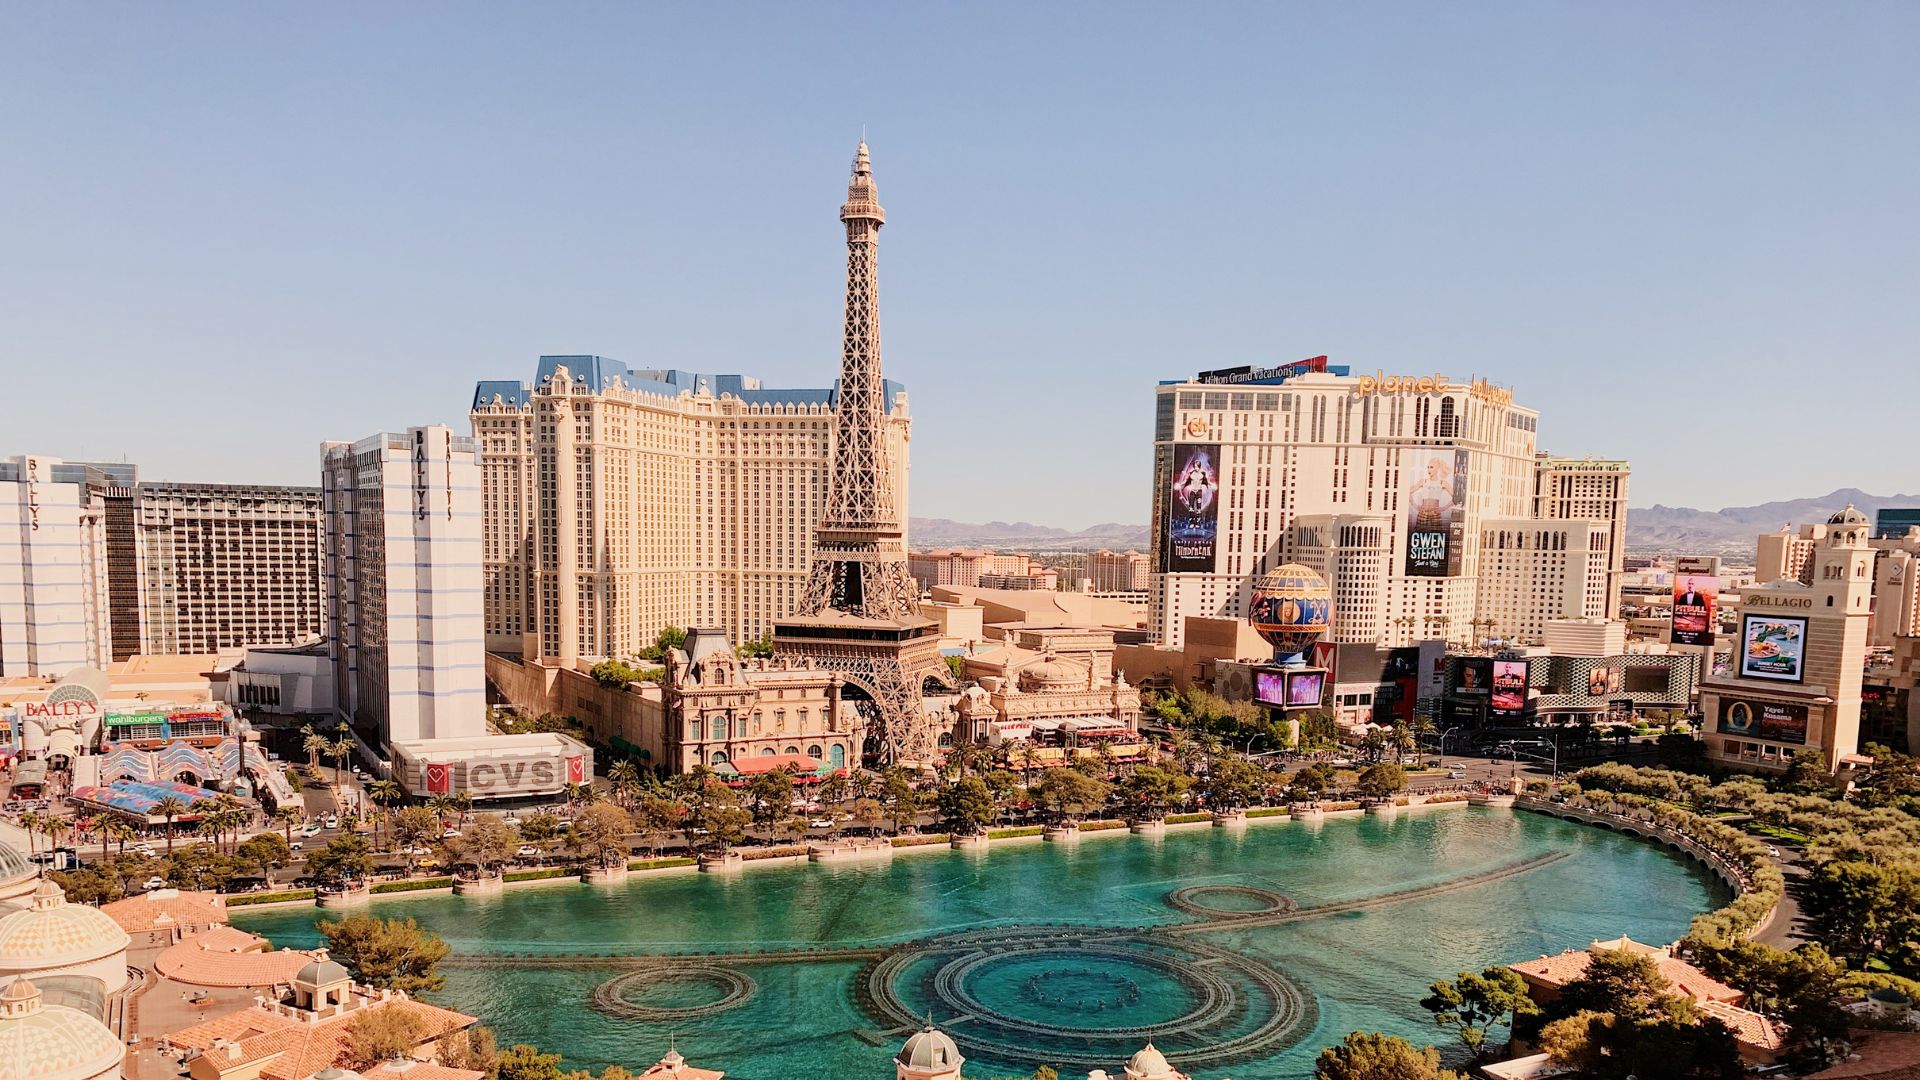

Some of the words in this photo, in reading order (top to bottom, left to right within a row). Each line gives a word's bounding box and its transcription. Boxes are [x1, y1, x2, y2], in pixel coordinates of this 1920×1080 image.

[1229, 371, 1252, 383] Grand
[1359, 369, 1449, 398] planet
[1411, 532, 1446, 548] GWEN
[1410, 547, 1445, 560] STEFANI
[1743, 594, 1812, 608] BELLAGIO
[1675, 604, 1706, 612] PITBULL
[1315, 647, 1335, 674] M
[1763, 712, 1792, 721] Kusama
[1764, 706, 1784, 714] Yayoi
[107, 713, 163, 724] wahlburgers
[470, 760, 553, 790] CVS
